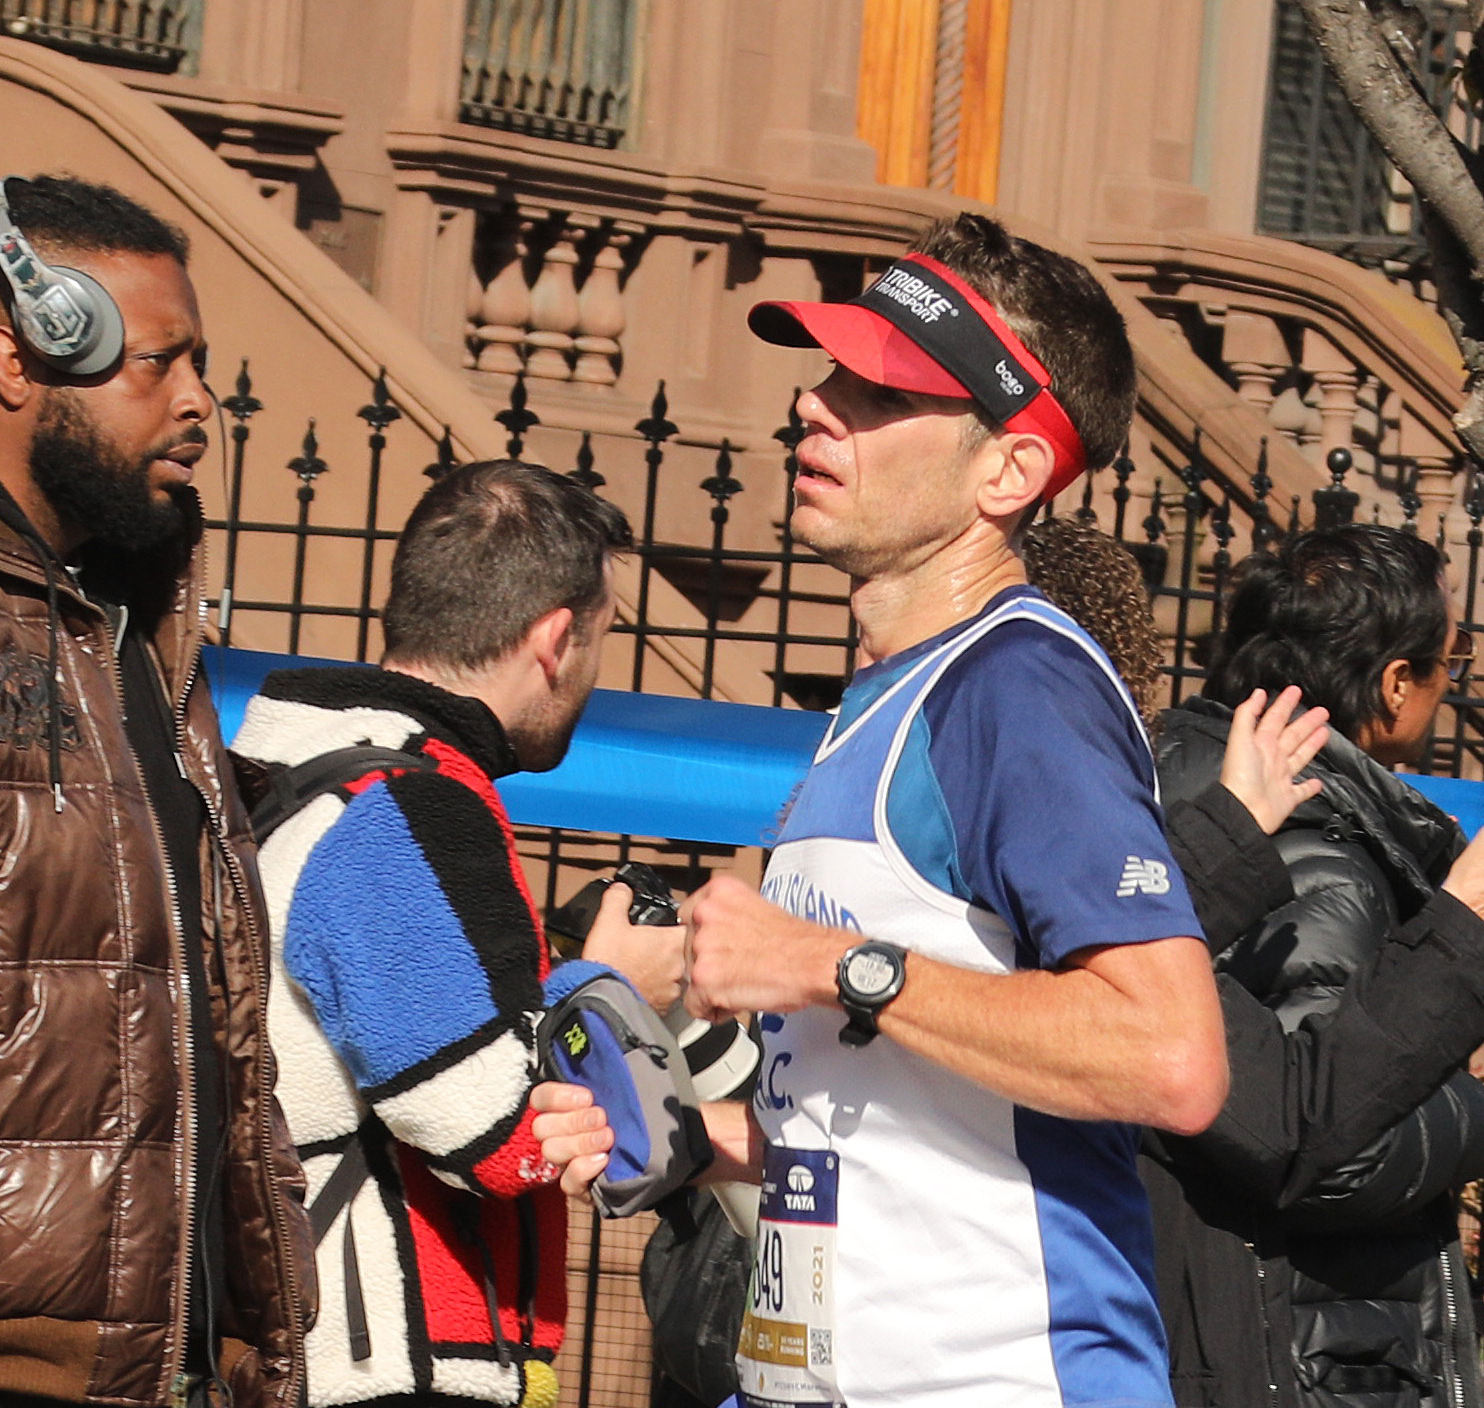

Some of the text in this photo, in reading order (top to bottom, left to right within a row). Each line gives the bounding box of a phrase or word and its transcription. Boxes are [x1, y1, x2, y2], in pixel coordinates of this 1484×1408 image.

[875, 282, 939, 323] TRANSPORT
[885, 268, 953, 317] TRIBIKE
[784, 1193, 816, 1212] TATA
[812, 1245, 824, 1306] 2021
